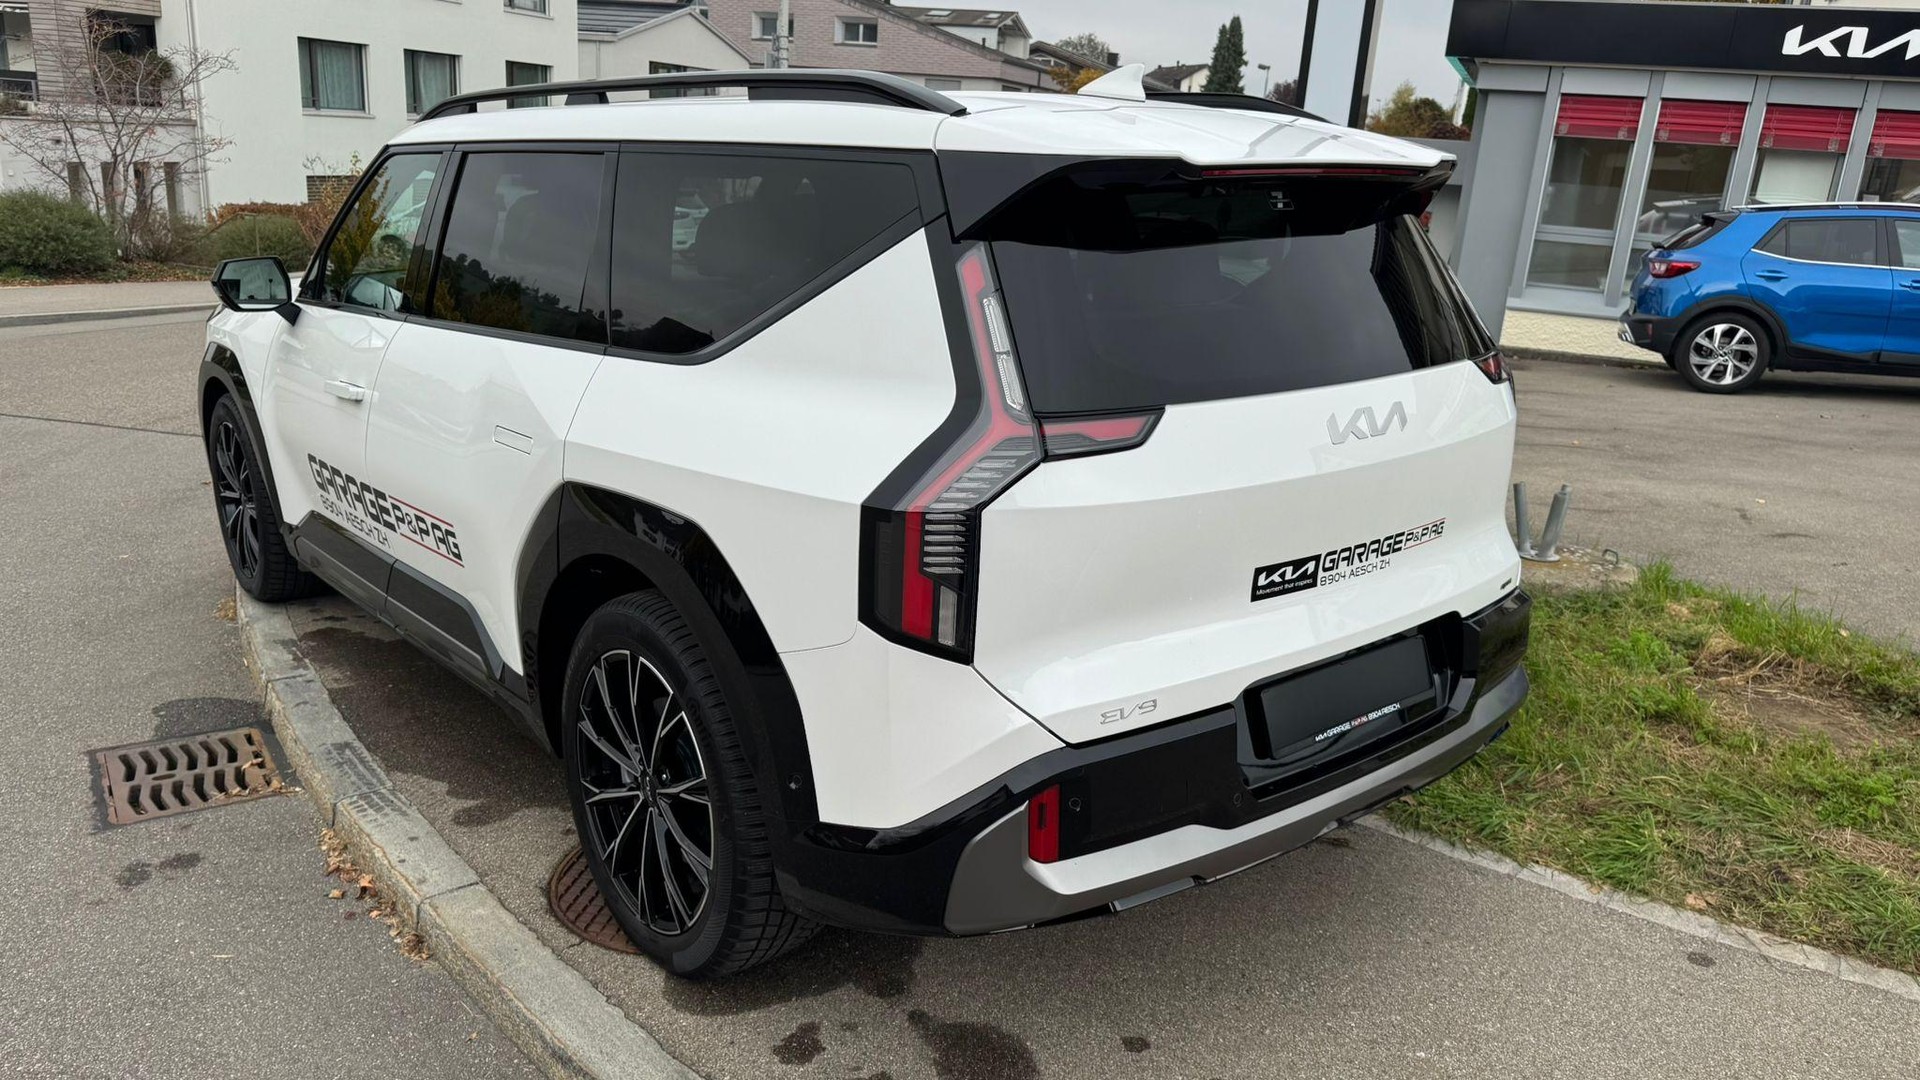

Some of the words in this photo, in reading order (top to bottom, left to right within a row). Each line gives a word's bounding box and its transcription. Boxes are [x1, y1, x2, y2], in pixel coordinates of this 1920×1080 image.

[1326, 400, 1408, 446] KIA
[307, 453, 398, 533] GARAGE
[390, 502, 431, 542] P&P
[430, 521, 463, 562] AG
[320, 493, 345, 521] 8904
[344, 509, 376, 541] AESCH
[373, 526, 391, 549] ZH
[1321, 531, 1406, 573] GARAGE
[1403, 527, 1430, 547] P&P
[1429, 520, 1446, 539] AG
[1256, 585, 1284, 596] Movement
[1284, 582, 1294, 590] that
[1257, 560, 1316, 587] KIA
[1320, 573, 1346, 587] 8904
[1348, 561, 1378, 579] AESCH
[1379, 558, 1391, 570] ZH
[1100, 698, 1158, 725] EV9
[1327, 721, 1351, 737] GARAGE
[1368, 709, 1381, 721] 8904
[1381, 702, 1400, 714] AESCH
